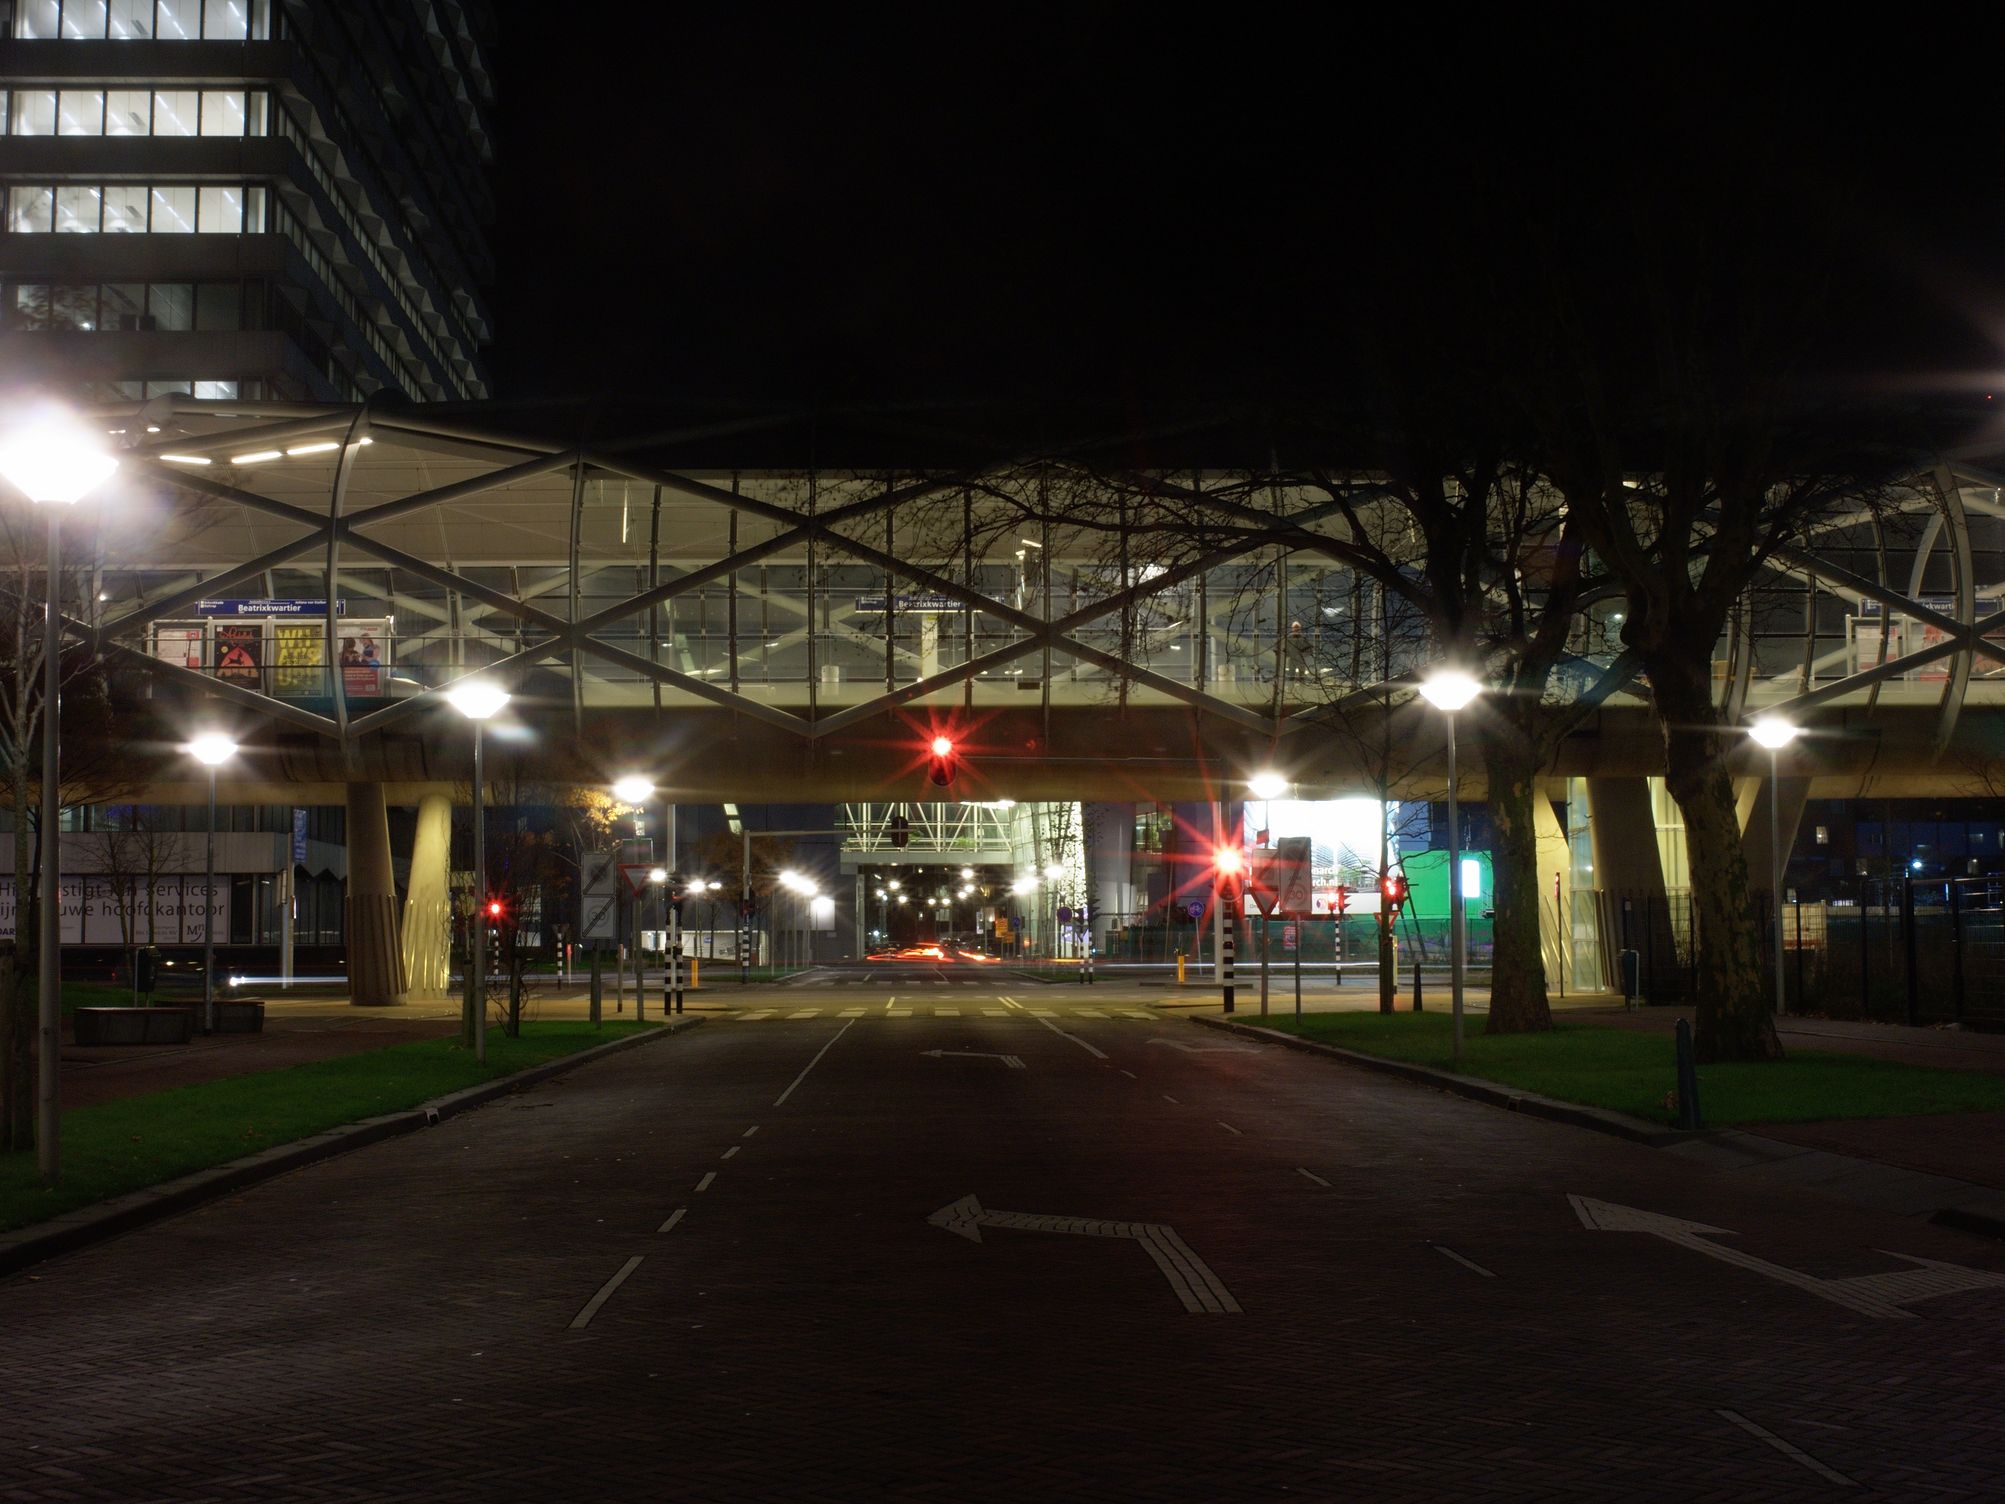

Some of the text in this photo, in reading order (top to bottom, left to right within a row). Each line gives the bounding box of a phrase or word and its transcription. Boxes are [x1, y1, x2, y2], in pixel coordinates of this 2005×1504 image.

[238, 604, 301, 612] Beatrixkwartier
[1312, 876, 1338, 886] rch.nl
[62, 882, 102, 900] stigt
